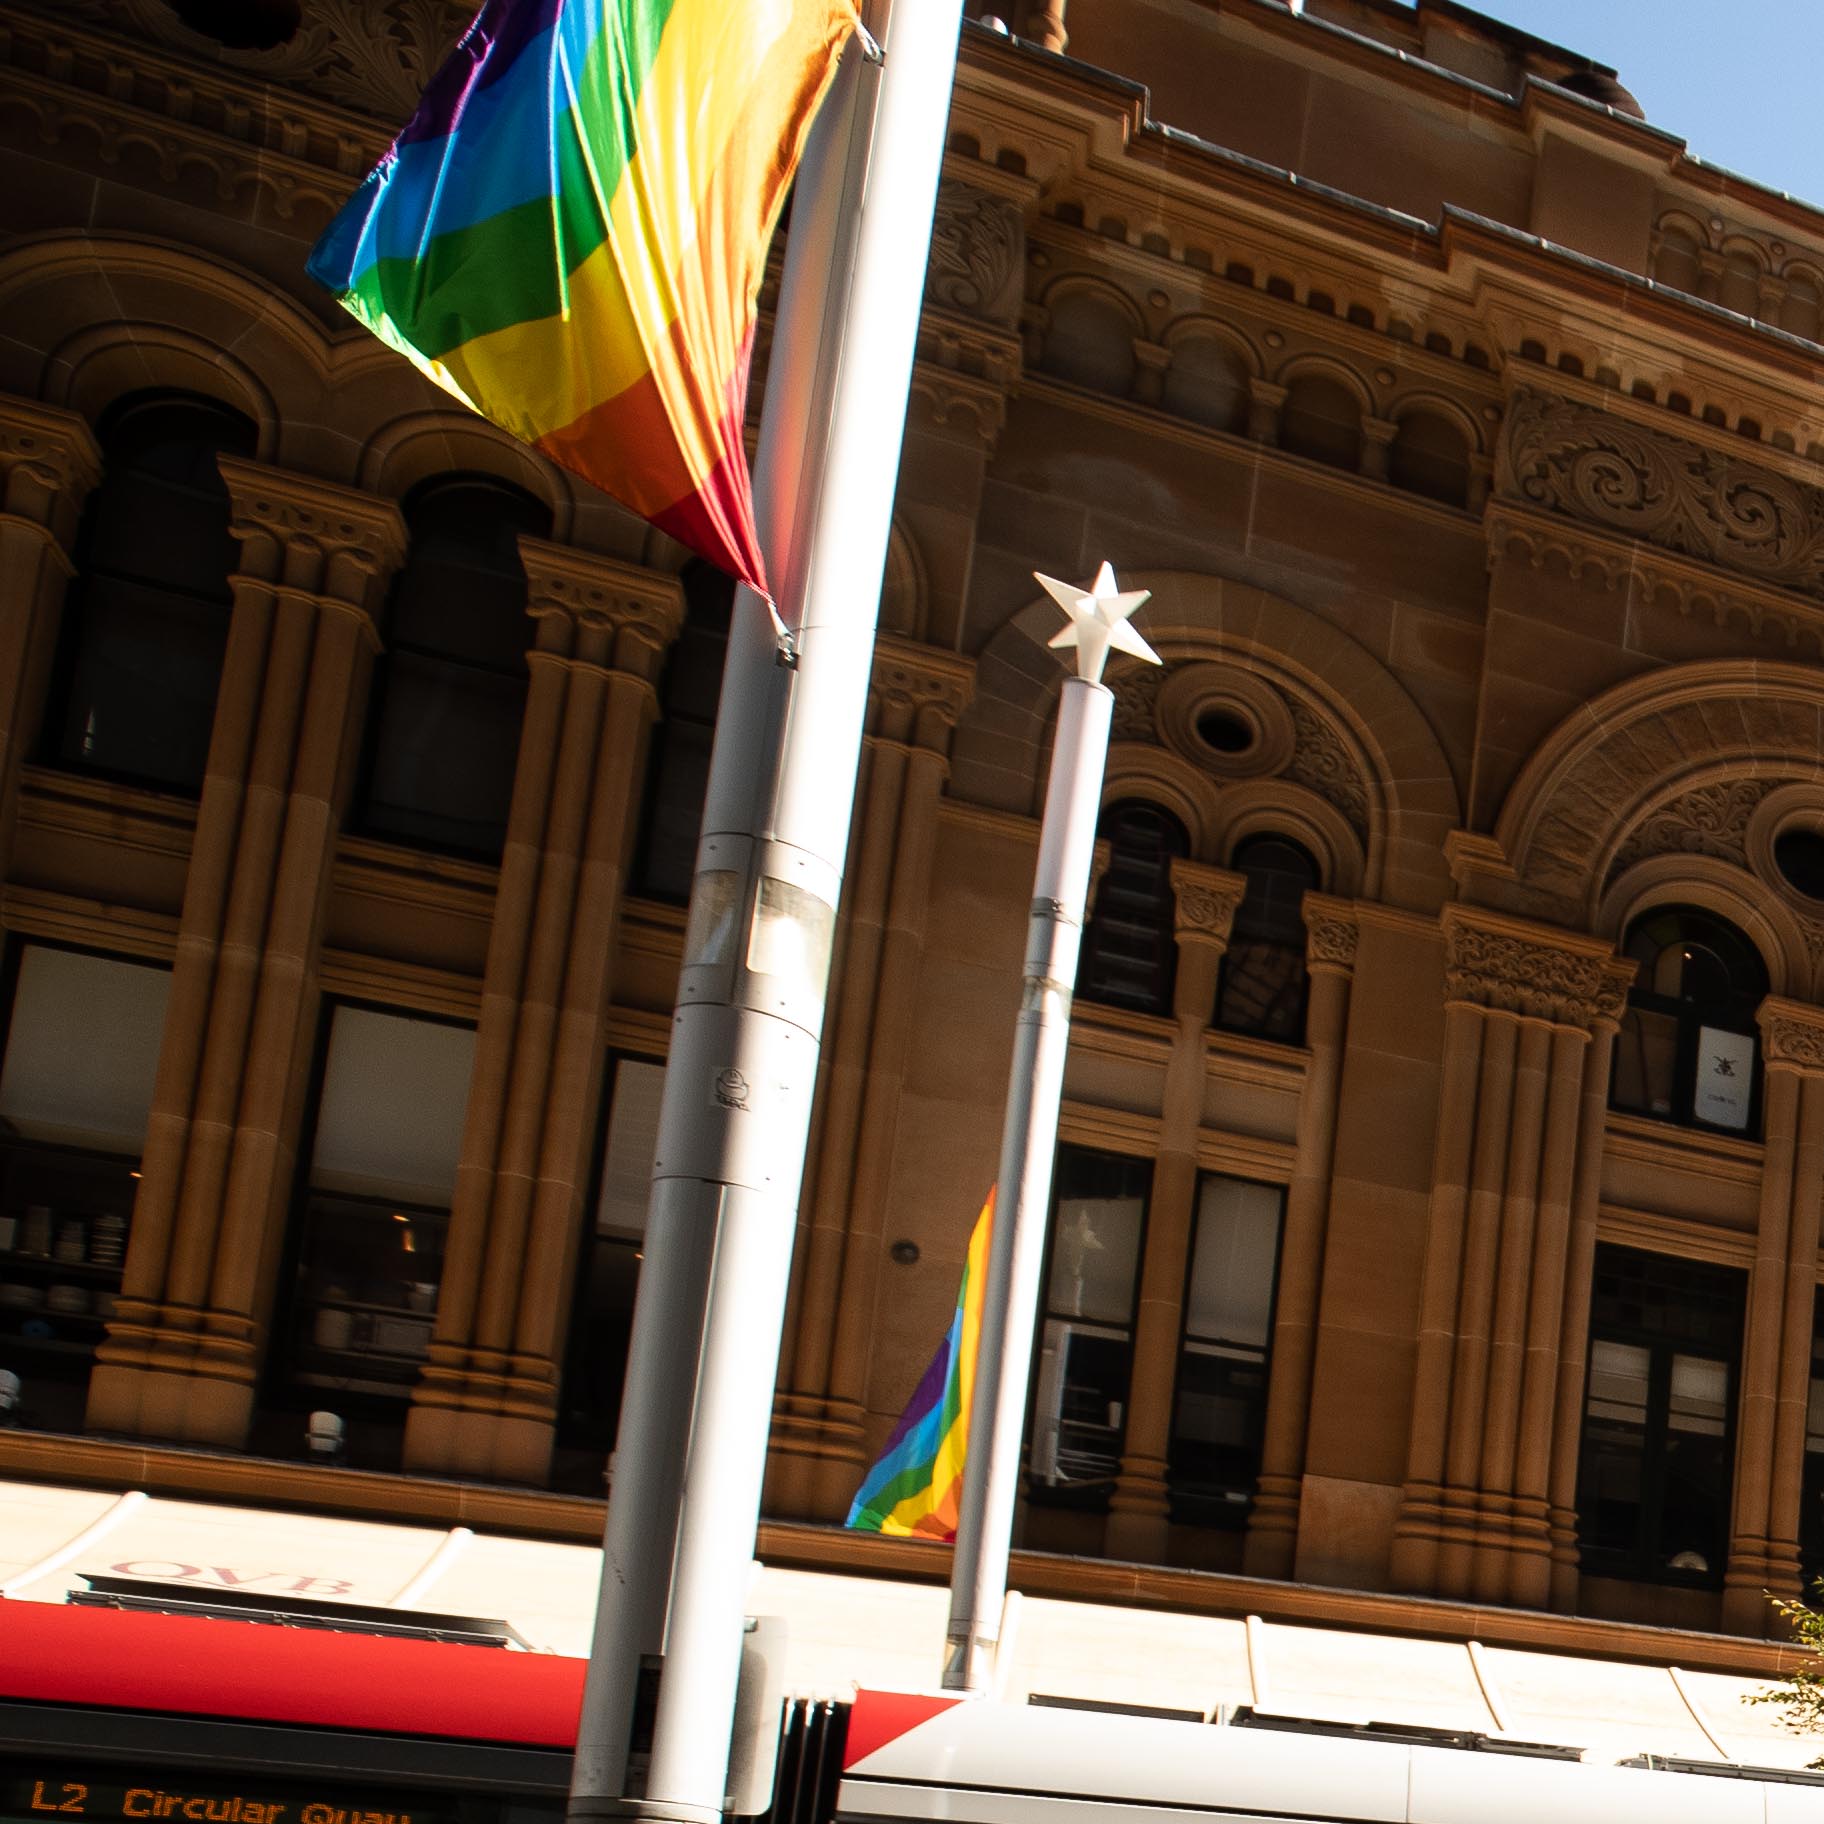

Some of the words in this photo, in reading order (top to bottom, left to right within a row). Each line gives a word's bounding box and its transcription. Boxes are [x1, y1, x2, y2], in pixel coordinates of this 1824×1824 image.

[110, 1560, 355, 1596] QVB
[32, 1781, 87, 1813] L2
[123, 1789, 286, 1824] Circular
